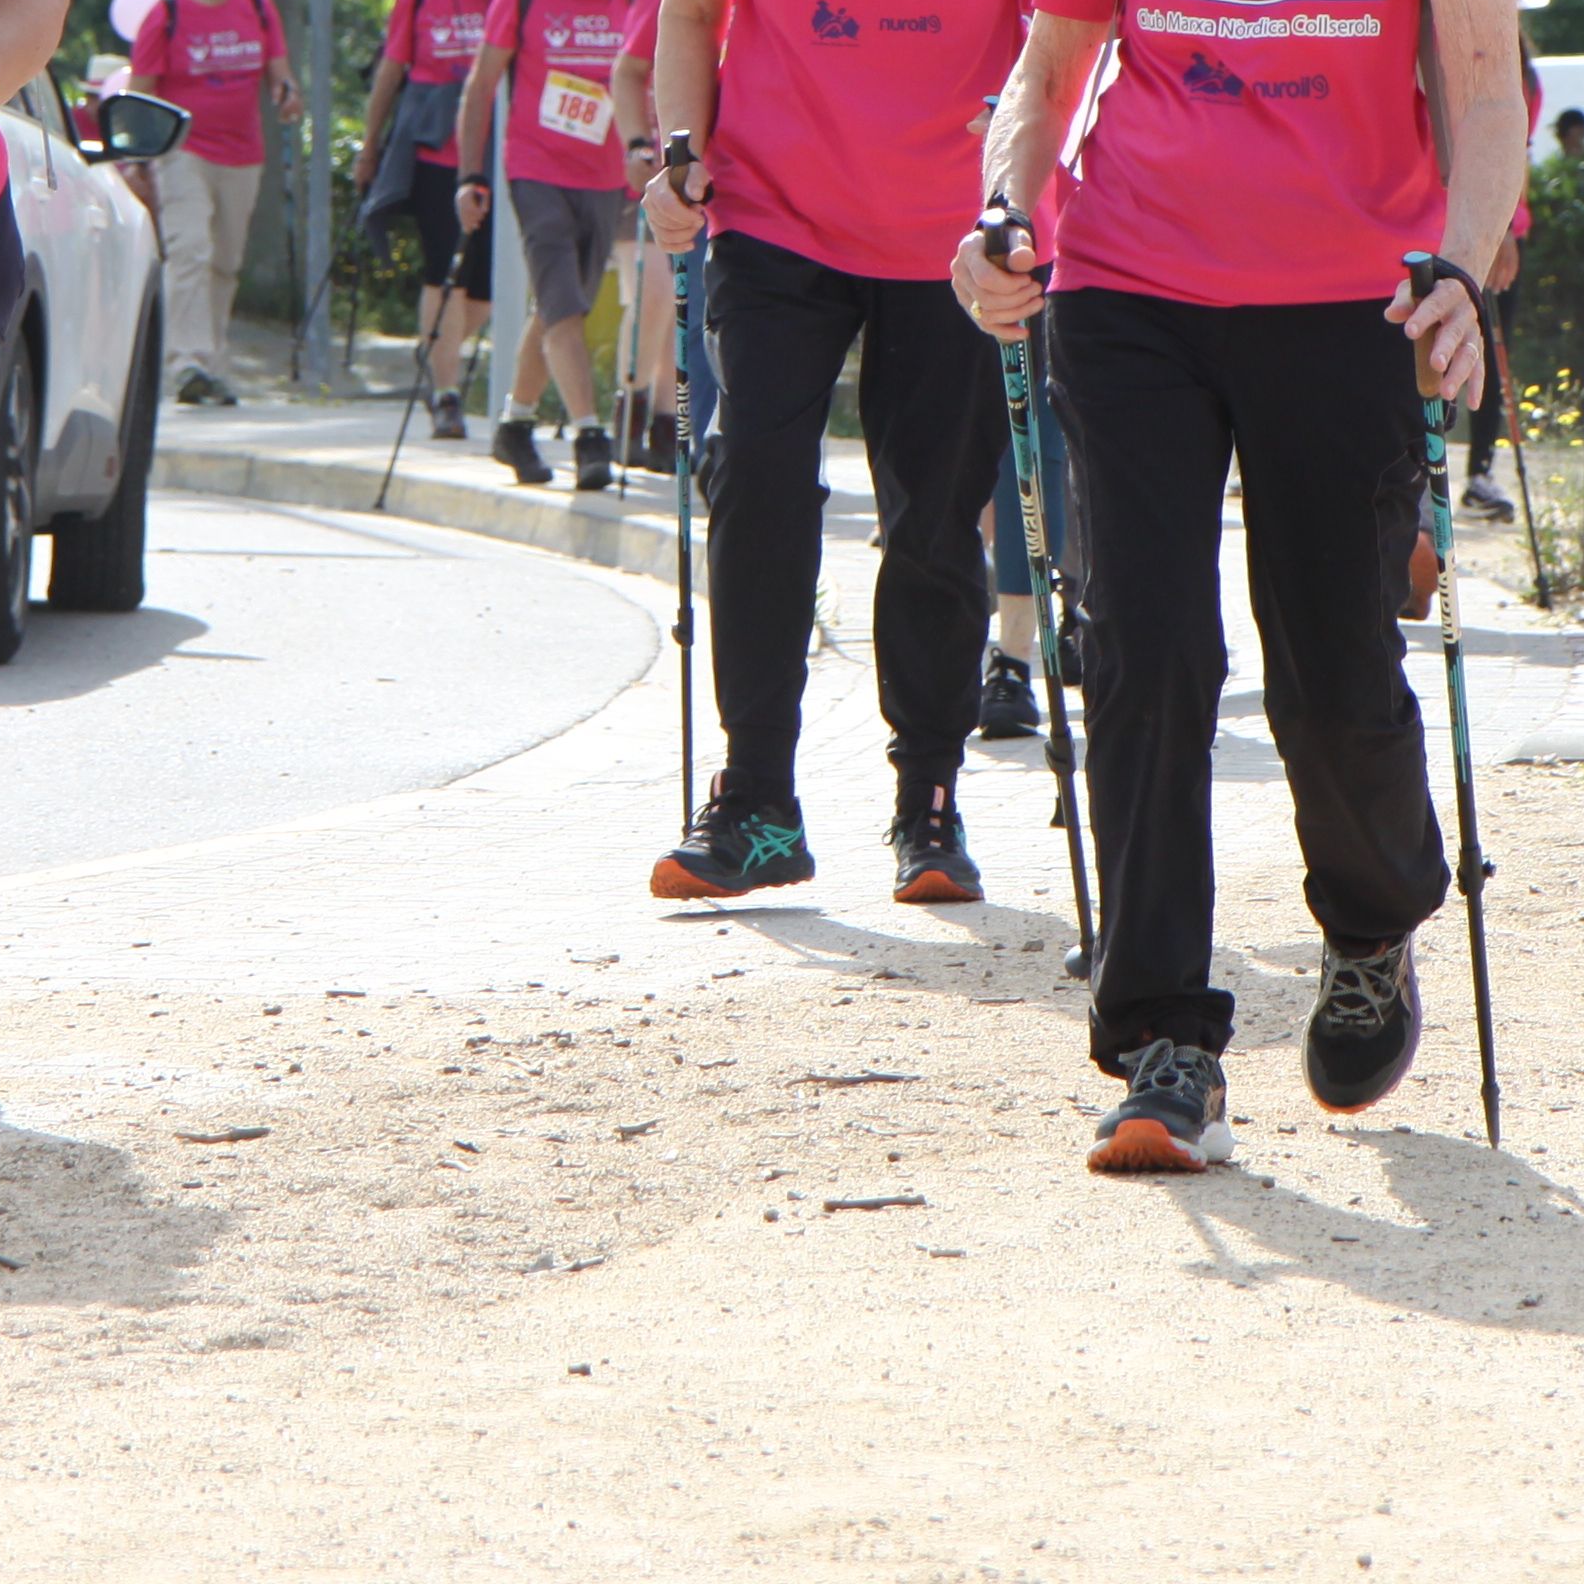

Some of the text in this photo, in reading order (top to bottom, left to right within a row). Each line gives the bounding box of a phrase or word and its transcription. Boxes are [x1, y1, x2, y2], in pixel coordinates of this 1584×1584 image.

[1136, 9, 1380, 39] Club Marxa Nòrdica Collserola
[558, 93, 599, 125] 188
